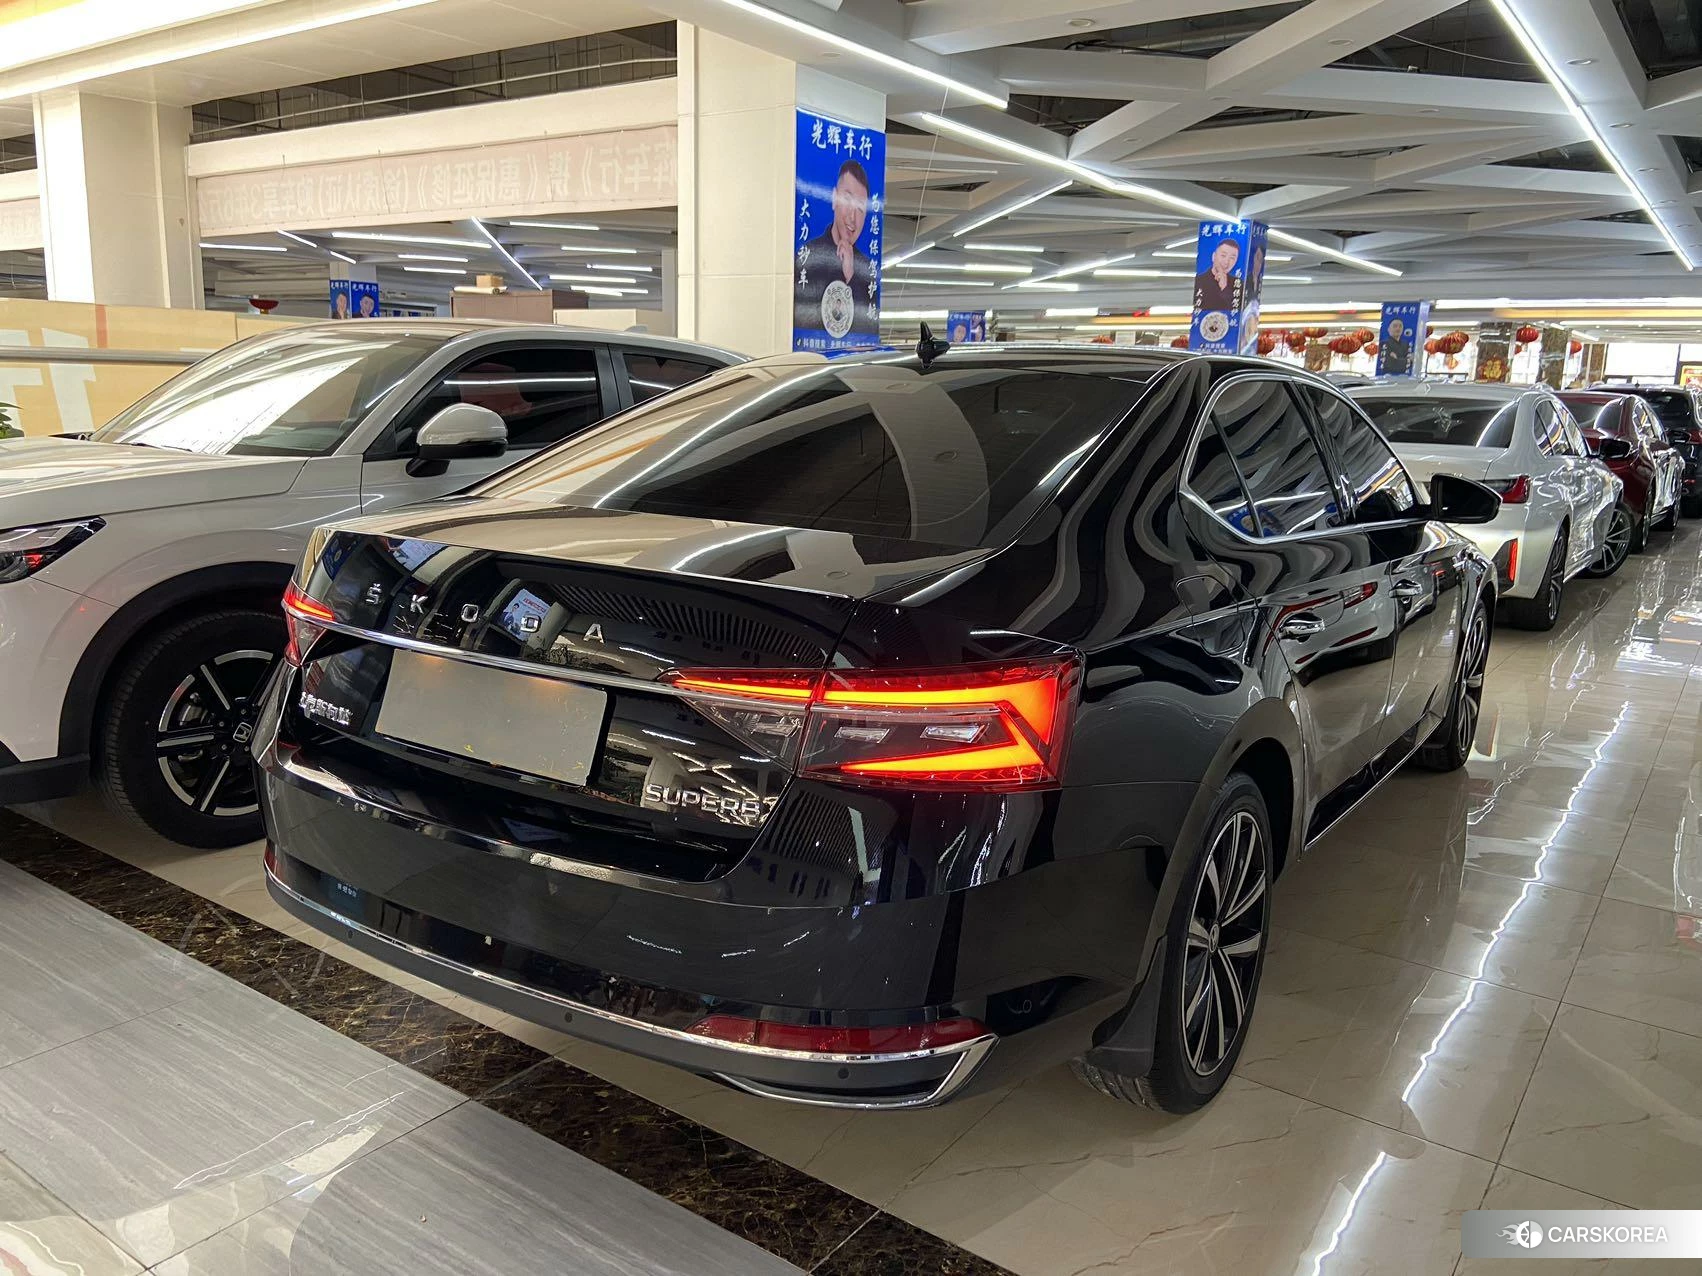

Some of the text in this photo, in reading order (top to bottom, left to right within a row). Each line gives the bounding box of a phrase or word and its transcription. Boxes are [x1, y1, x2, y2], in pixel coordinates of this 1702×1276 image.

[810, 119, 873, 161] 光辉车行
[1201, 223, 1247, 237] 光辉车行
[866, 192, 881, 321] 为您保驾护航
[645, 783, 760, 818] SUPERB
